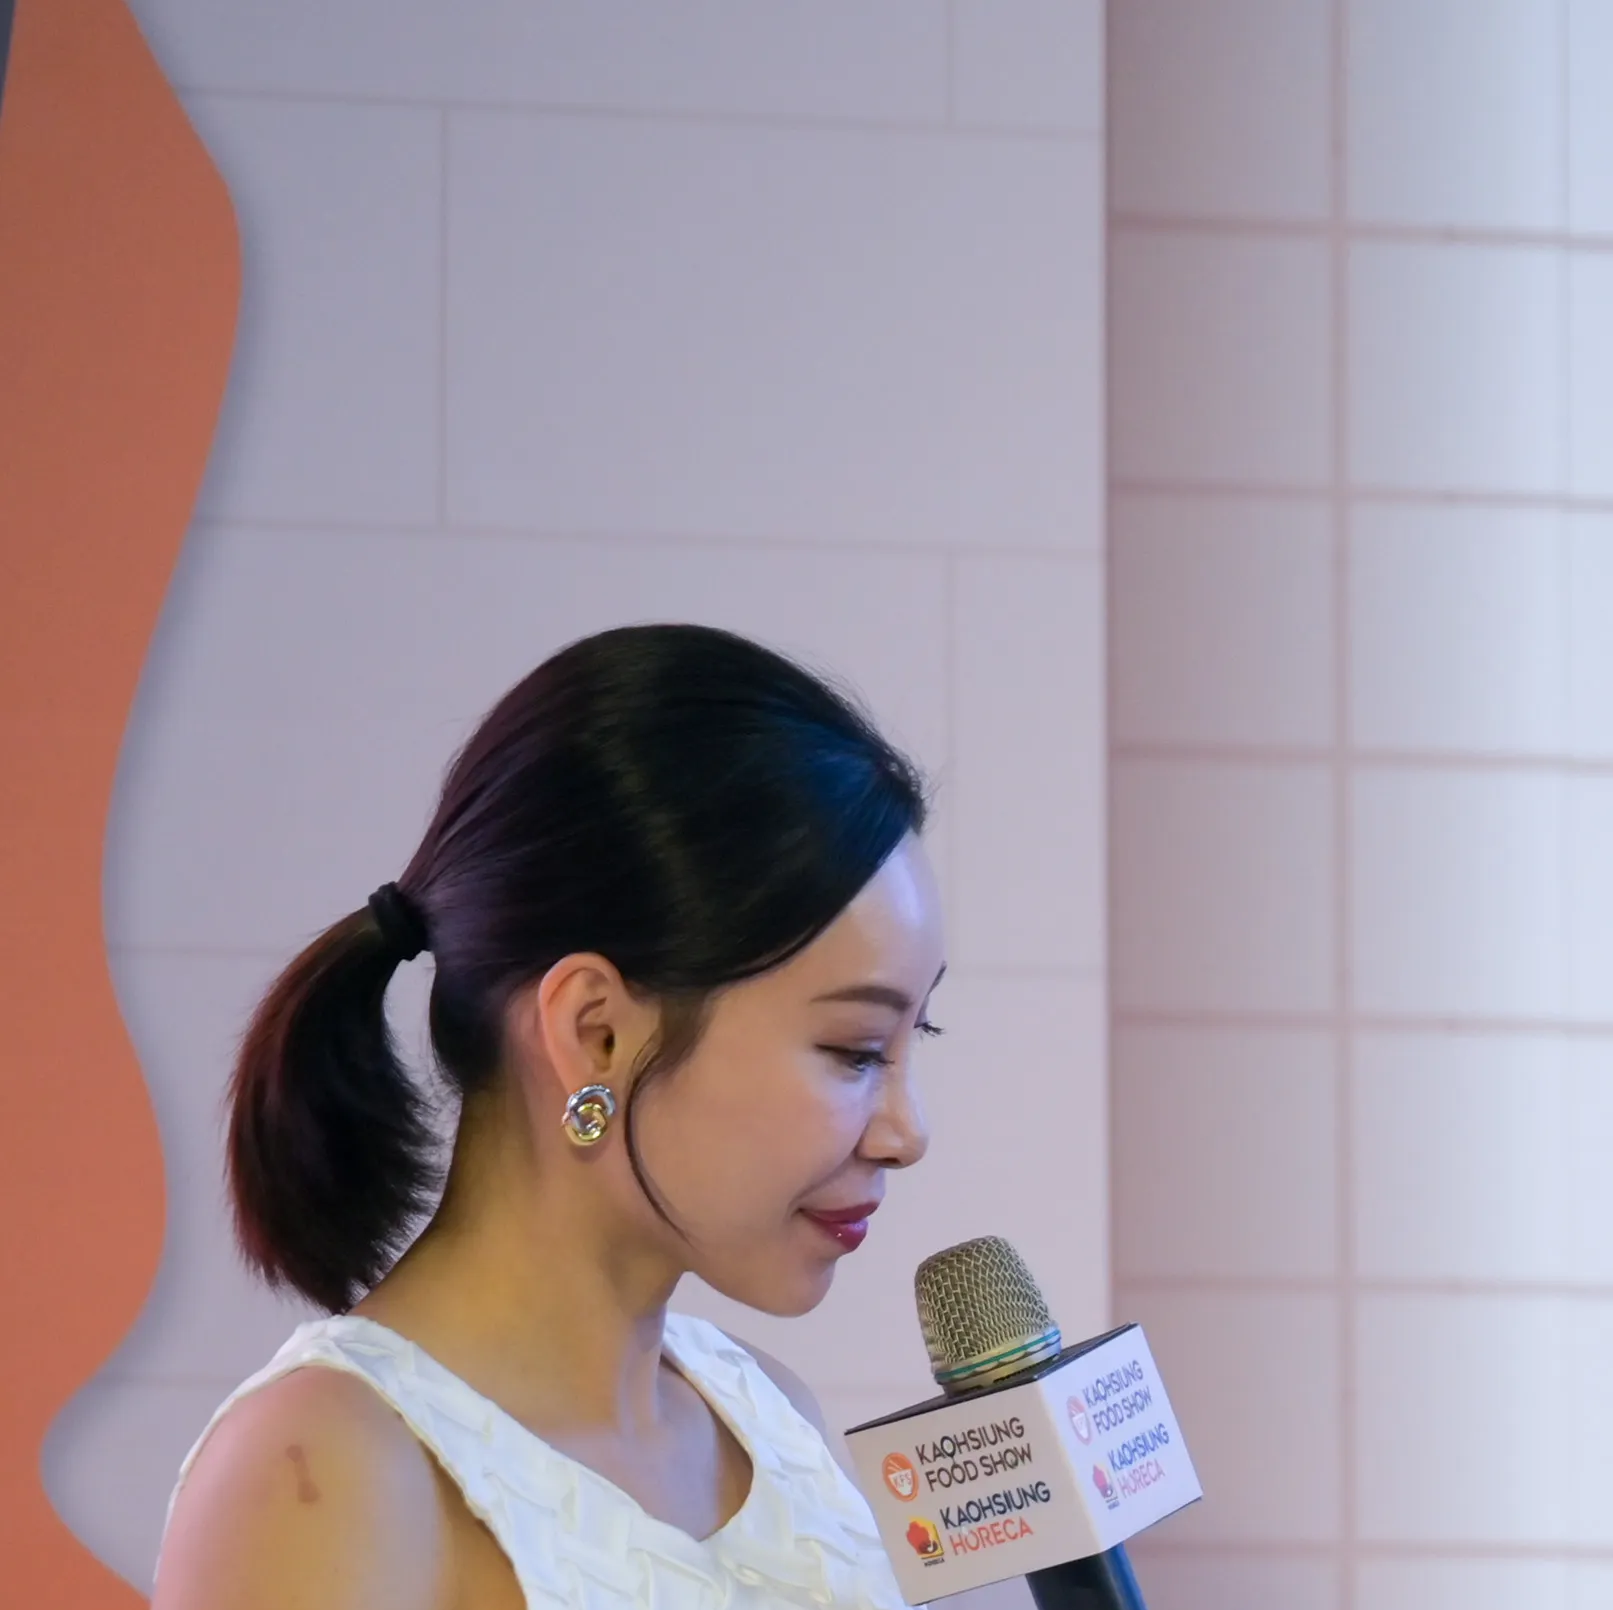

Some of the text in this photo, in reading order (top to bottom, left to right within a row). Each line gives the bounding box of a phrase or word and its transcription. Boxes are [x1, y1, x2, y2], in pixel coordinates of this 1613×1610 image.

[1083, 1360, 1143, 1407] KAOHSIUNG
[1093, 1403, 1124, 1434] FOOD
[1122, 1386, 1153, 1420] SHOW
[915, 1417, 1025, 1465] KAOHSIUNG
[1107, 1423, 1170, 1472] KAOHSIUNG
[925, 1443, 1033, 1492] FOOD SHOW
[1117, 1459, 1166, 1499] HORECA
[940, 1481, 1051, 1529] KAOHSIUNG
[949, 1516, 1034, 1556] HORECA
